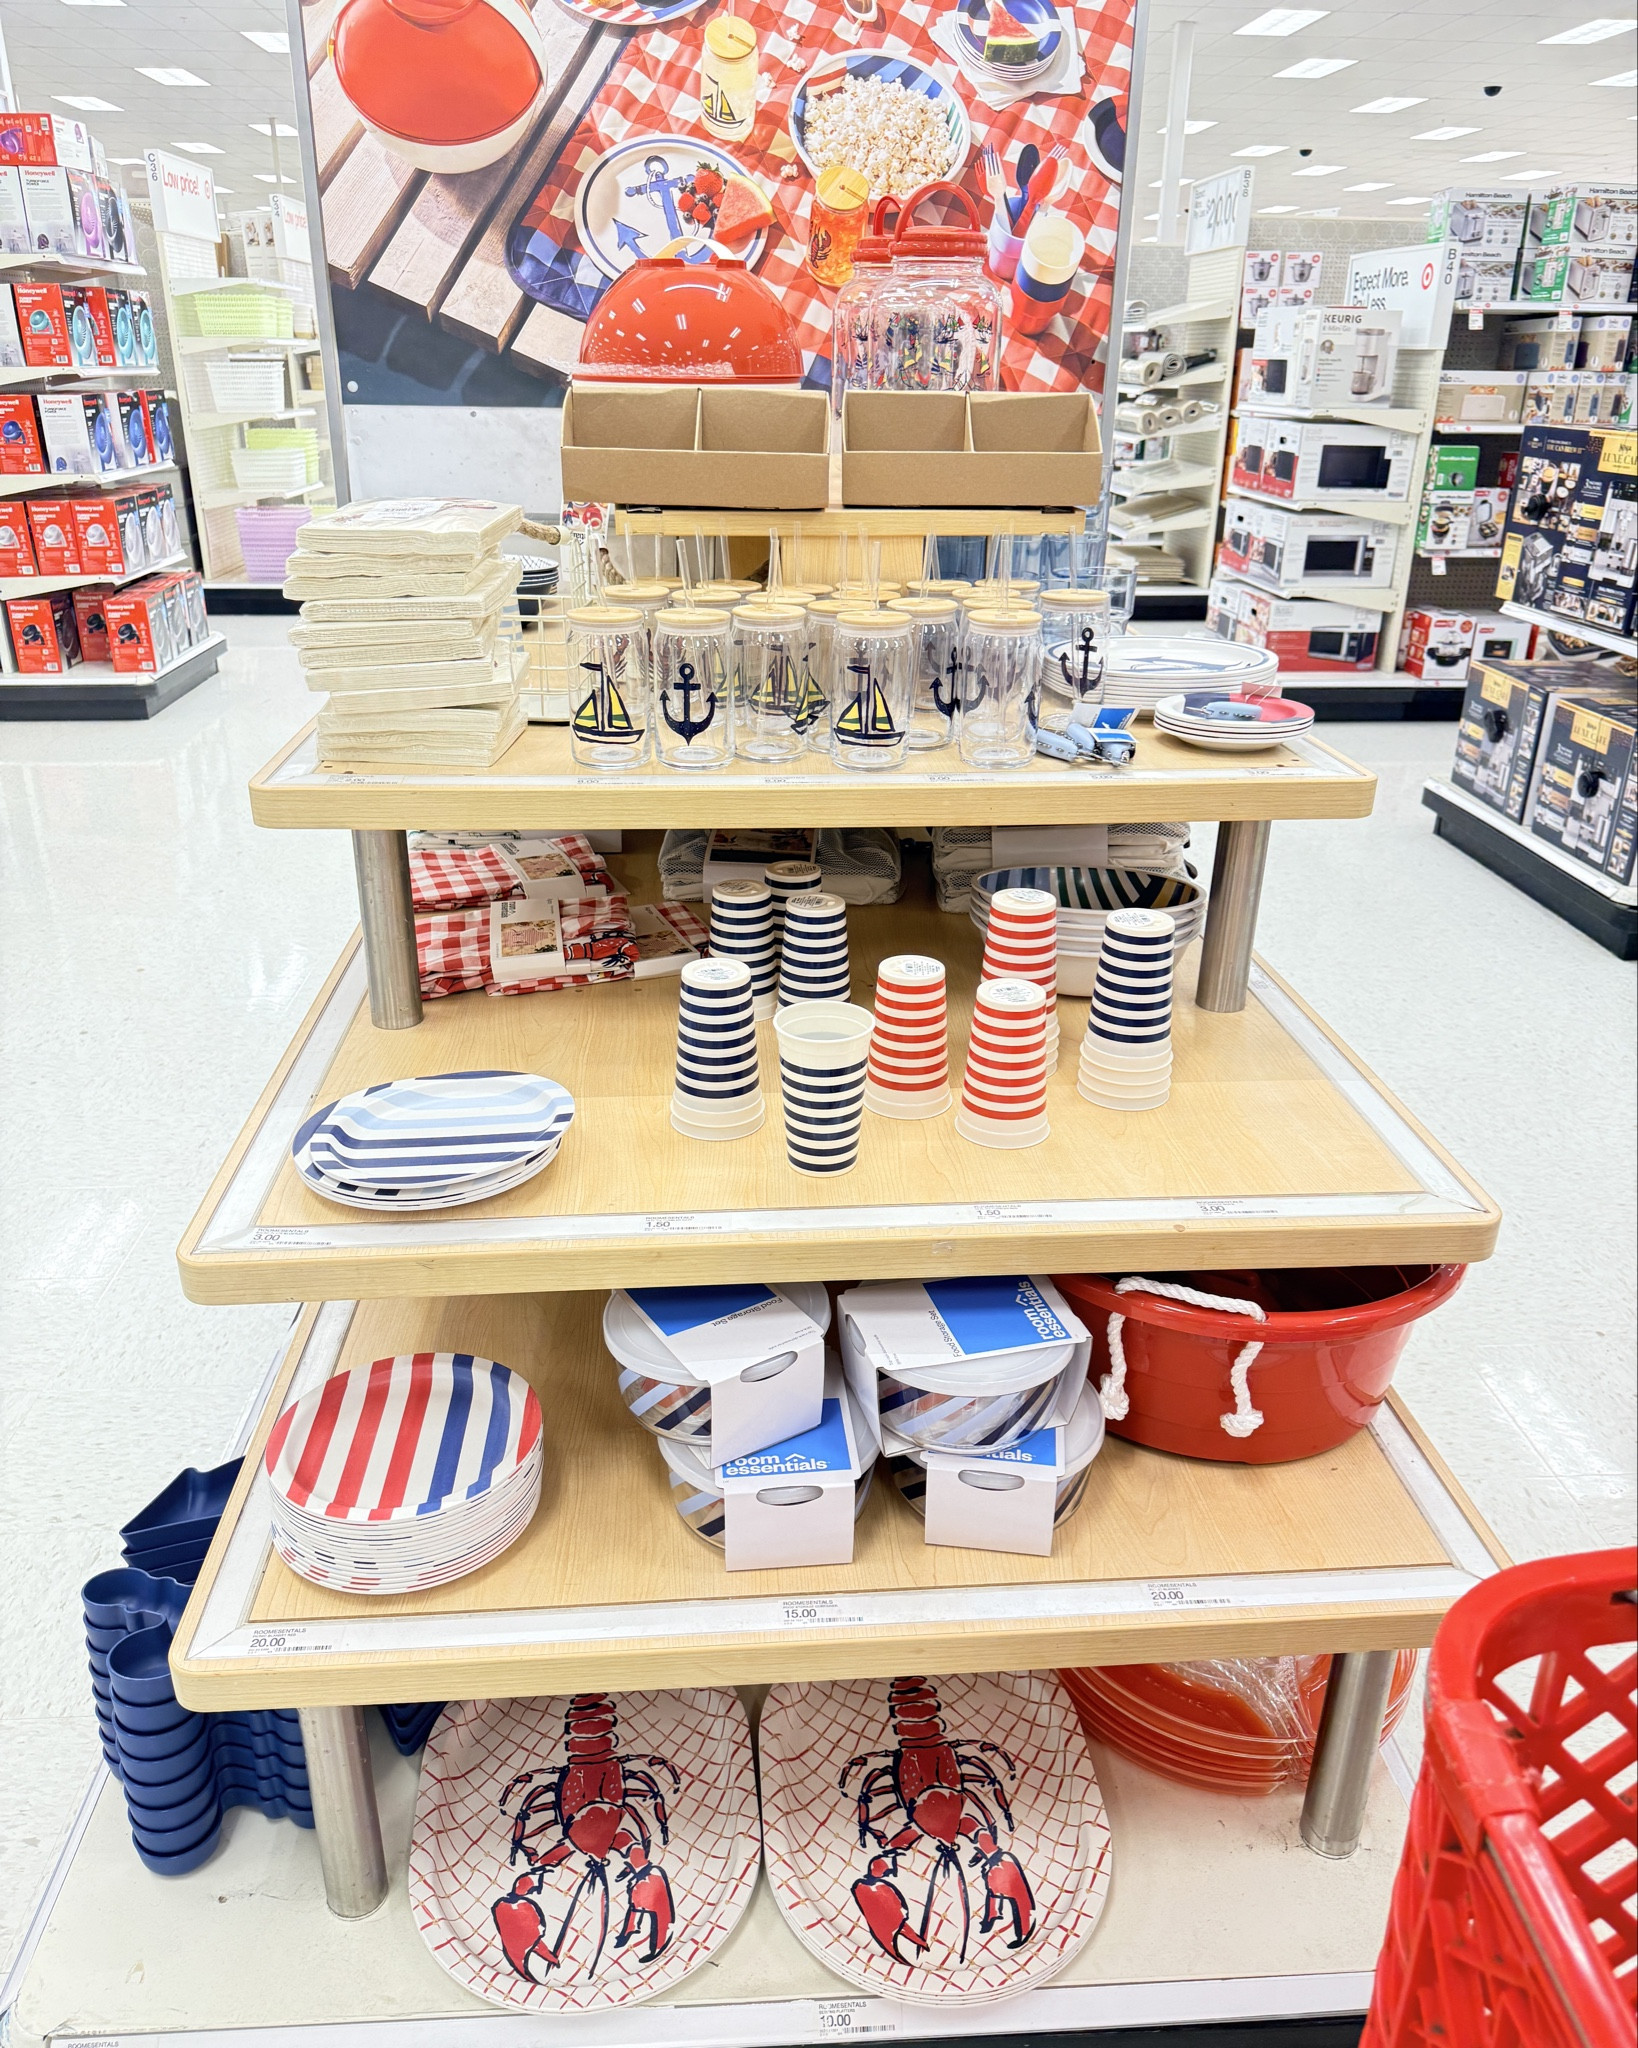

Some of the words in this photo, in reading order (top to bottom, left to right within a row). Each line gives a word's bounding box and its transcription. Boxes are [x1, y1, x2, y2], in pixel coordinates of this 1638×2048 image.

[162, 165, 178, 190] Low
[180, 173, 200, 196] price!
[284, 207, 294, 224] Low
[1354, 269, 1381, 296] Expect
[1382, 267, 1408, 289] More.
[17, 287, 48, 295] Honeywell
[1324, 314, 1362, 323] KEURIG
[760, 1298, 783, 1309] Food
[1018, 1281, 1066, 1338] essentials
[728, 1306, 761, 1320] Storage
[928, 1310, 939, 1320] Set
[712, 1318, 728, 1327] Set
[1024, 1308, 1054, 1340] room
[936, 1320, 952, 1342] Storage
[948, 1342, 962, 1357] Food
[726, 1458, 828, 1476] essentials
[1151, 1591, 1184, 1600] 20.00
[785, 1609, 816, 1618] 15.00
[250, 1638, 286, 1647] 20.00
